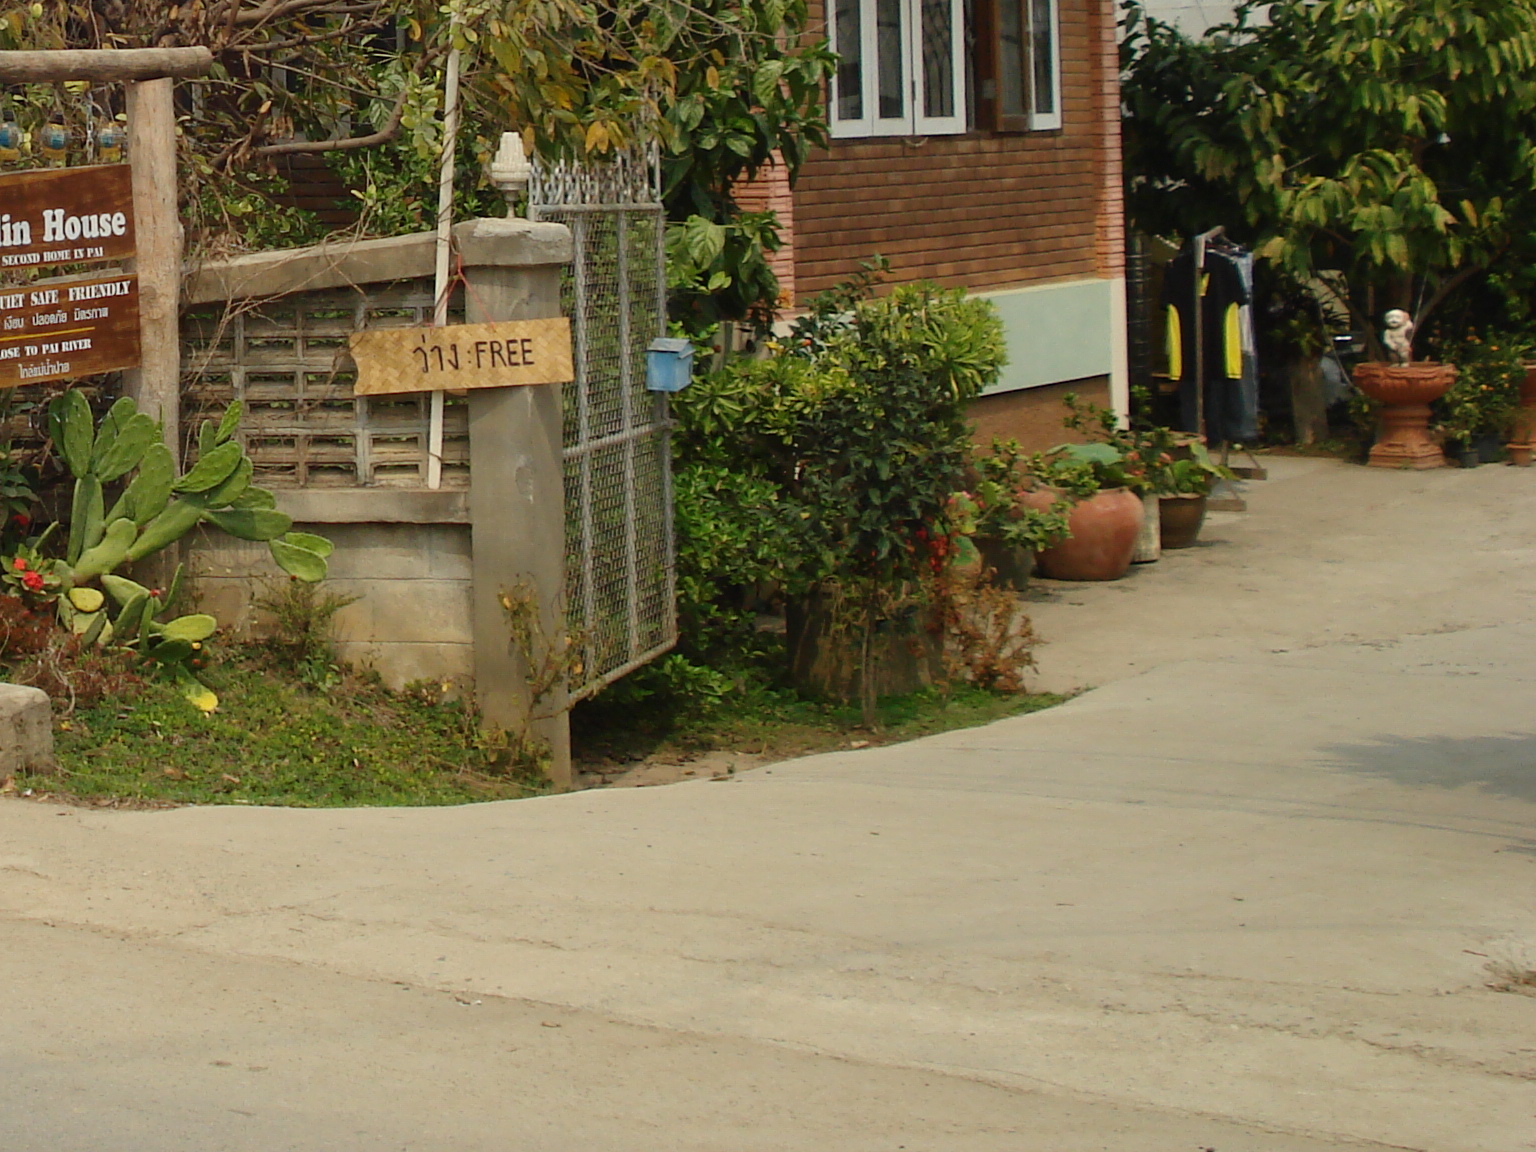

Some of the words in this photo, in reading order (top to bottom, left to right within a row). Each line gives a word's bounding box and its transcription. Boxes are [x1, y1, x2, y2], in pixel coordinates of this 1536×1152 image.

[42, 209, 126, 242] House
[2, 254, 40, 266] SECOND
[43, 251, 71, 262] HOME
[74, 249, 84, 259] IN
[87, 247, 104, 258] PAI
[30, 290, 59, 306] SAFE
[68, 281, 131, 302] FRIENDLY
[32, 311, 67, 326] ปลอดภัย
[74, 307, 109, 321] มิตรภาพ
[24, 345, 38, 356] TO
[42, 343, 59, 354] PAI
[61, 339, 92, 352] RIVER
